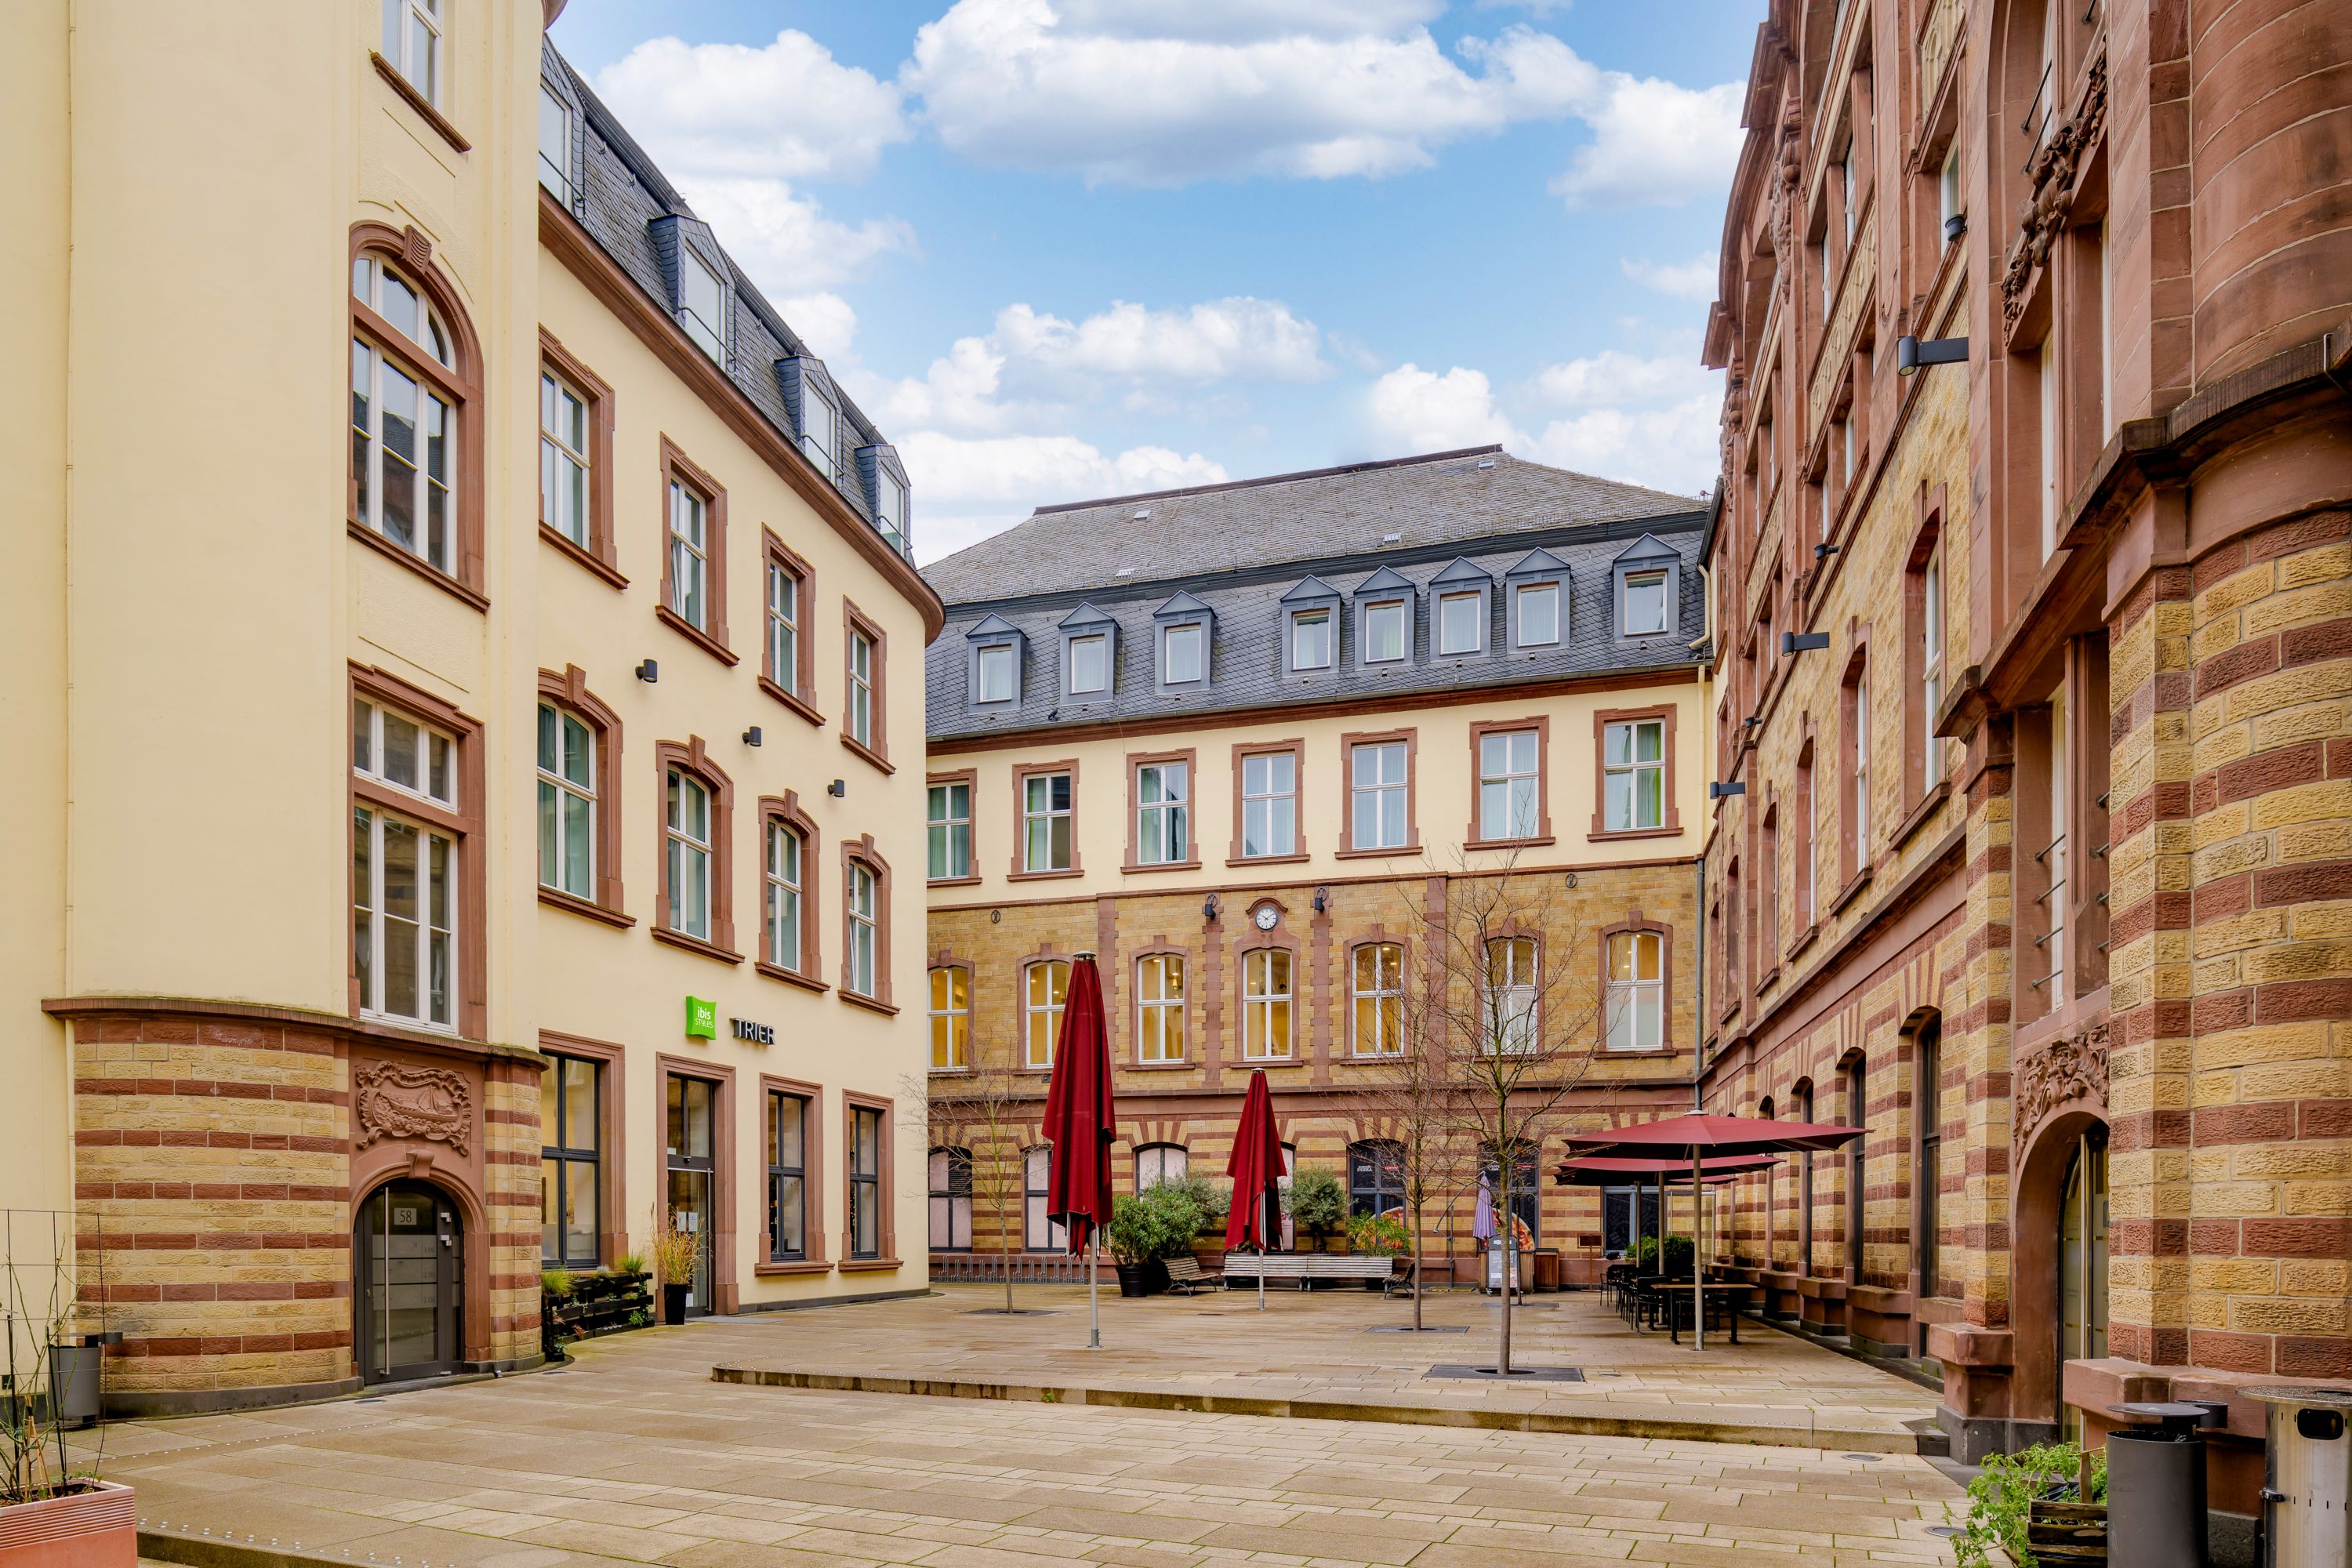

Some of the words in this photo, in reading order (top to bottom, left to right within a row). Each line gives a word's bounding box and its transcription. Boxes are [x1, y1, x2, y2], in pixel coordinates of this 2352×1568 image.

[697, 1007, 711, 1020] ibis
[735, 1018, 775, 1044] TRIER
[400, 1210, 412, 1223] 58
